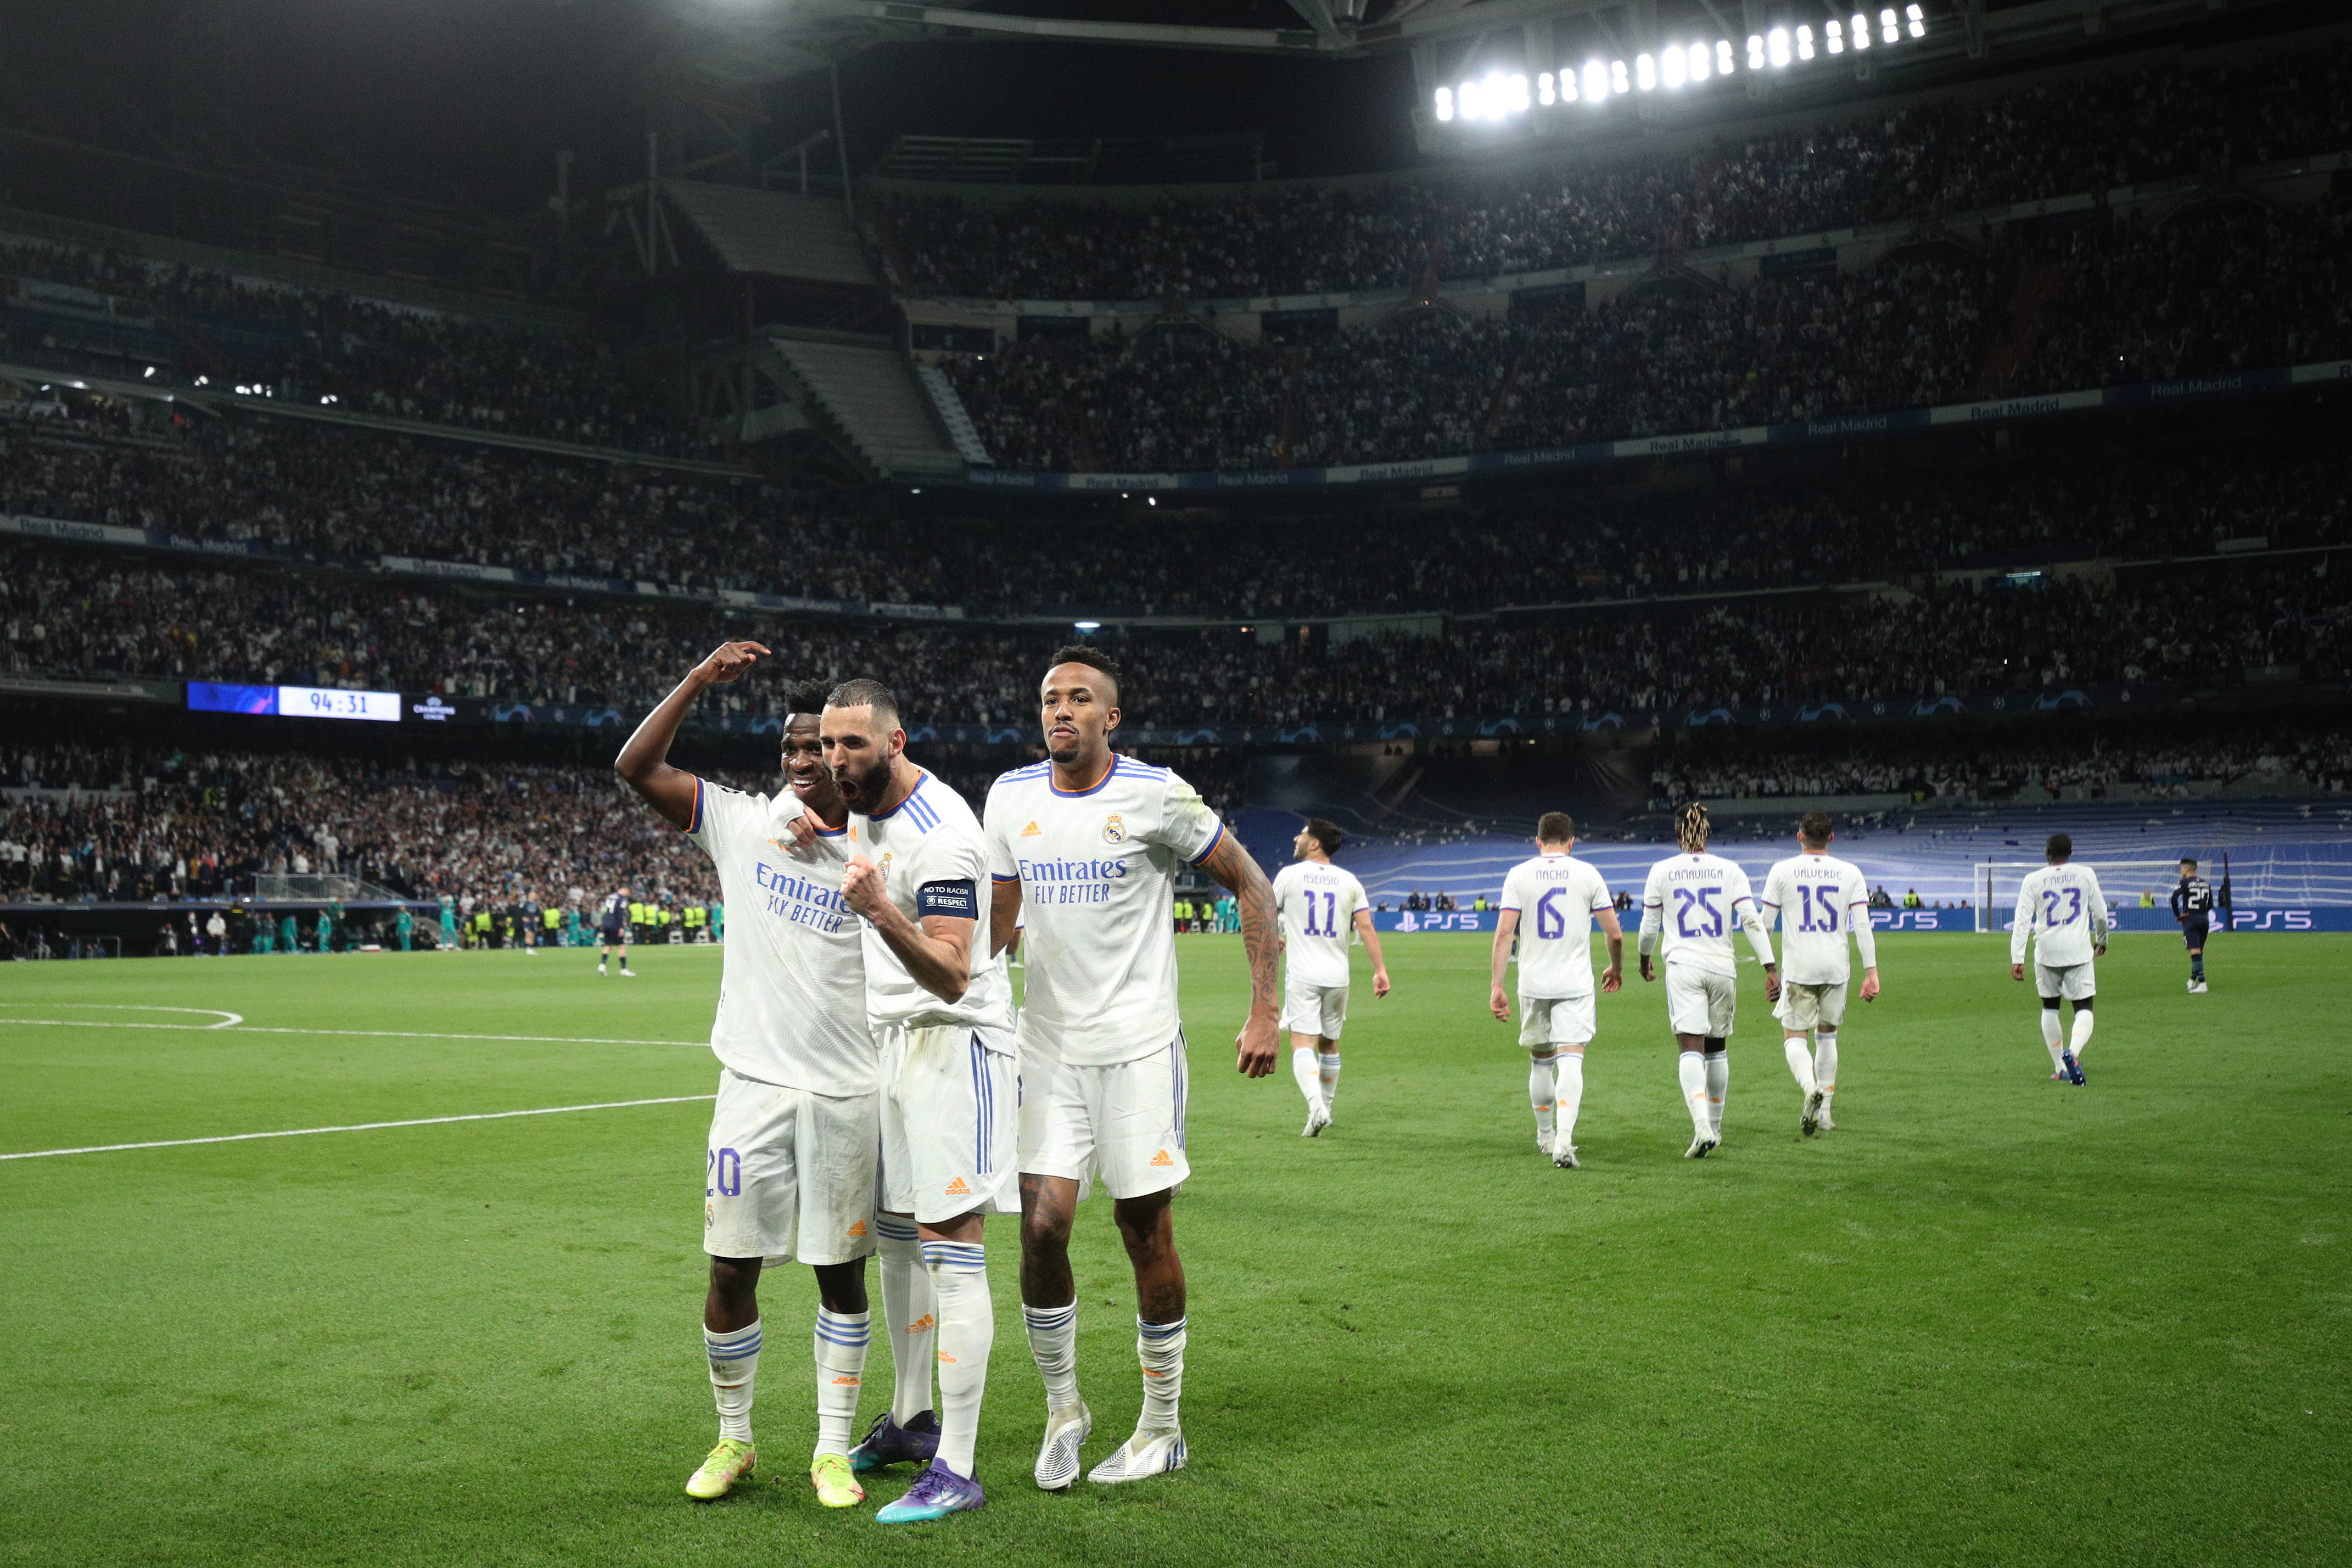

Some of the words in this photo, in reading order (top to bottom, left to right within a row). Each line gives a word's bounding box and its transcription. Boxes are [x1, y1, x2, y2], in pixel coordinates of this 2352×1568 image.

[2151, 383, 2183, 399] Real
[2189, 377, 2241, 393] Madrid
[1972, 407, 2002, 420] Real
[2007, 399, 2059, 415] Madrid
[1808, 422, 1836, 435] Real
[1841, 416, 1887, 431] Madrid
[1650, 440, 1679, 452] Real
[1391, 465, 1433, 478] Madrid
[1018, 857, 1127, 881] Emirates
[1303, 873, 1339, 886] ASENSIO
[1536, 869, 1569, 881] NACHO
[1668, 869, 1723, 881] CAMAVINGA
[938, 898, 967, 907] RESPECT
[1035, 886, 1054, 904] FLY
[1059, 883, 1110, 904] BETTER
[2187, 887, 2210, 910] 27
[767, 894, 789, 917] FLY
[790, 904, 843, 933] BETTER
[1304, 890, 1337, 938] 11
[1537, 887, 1567, 940] 6
[1673, 887, 1723, 938] 25
[1797, 885, 1839, 932] 15
[2042, 887, 2081, 927] 23
[1424, 913, 1479, 930] PS5
[1869, 911, 1939, 929] PS5
[2232, 910, 2312, 929] PS5
[706, 1147, 741, 1197] 20
[944, 1187, 971, 1195] adidas
